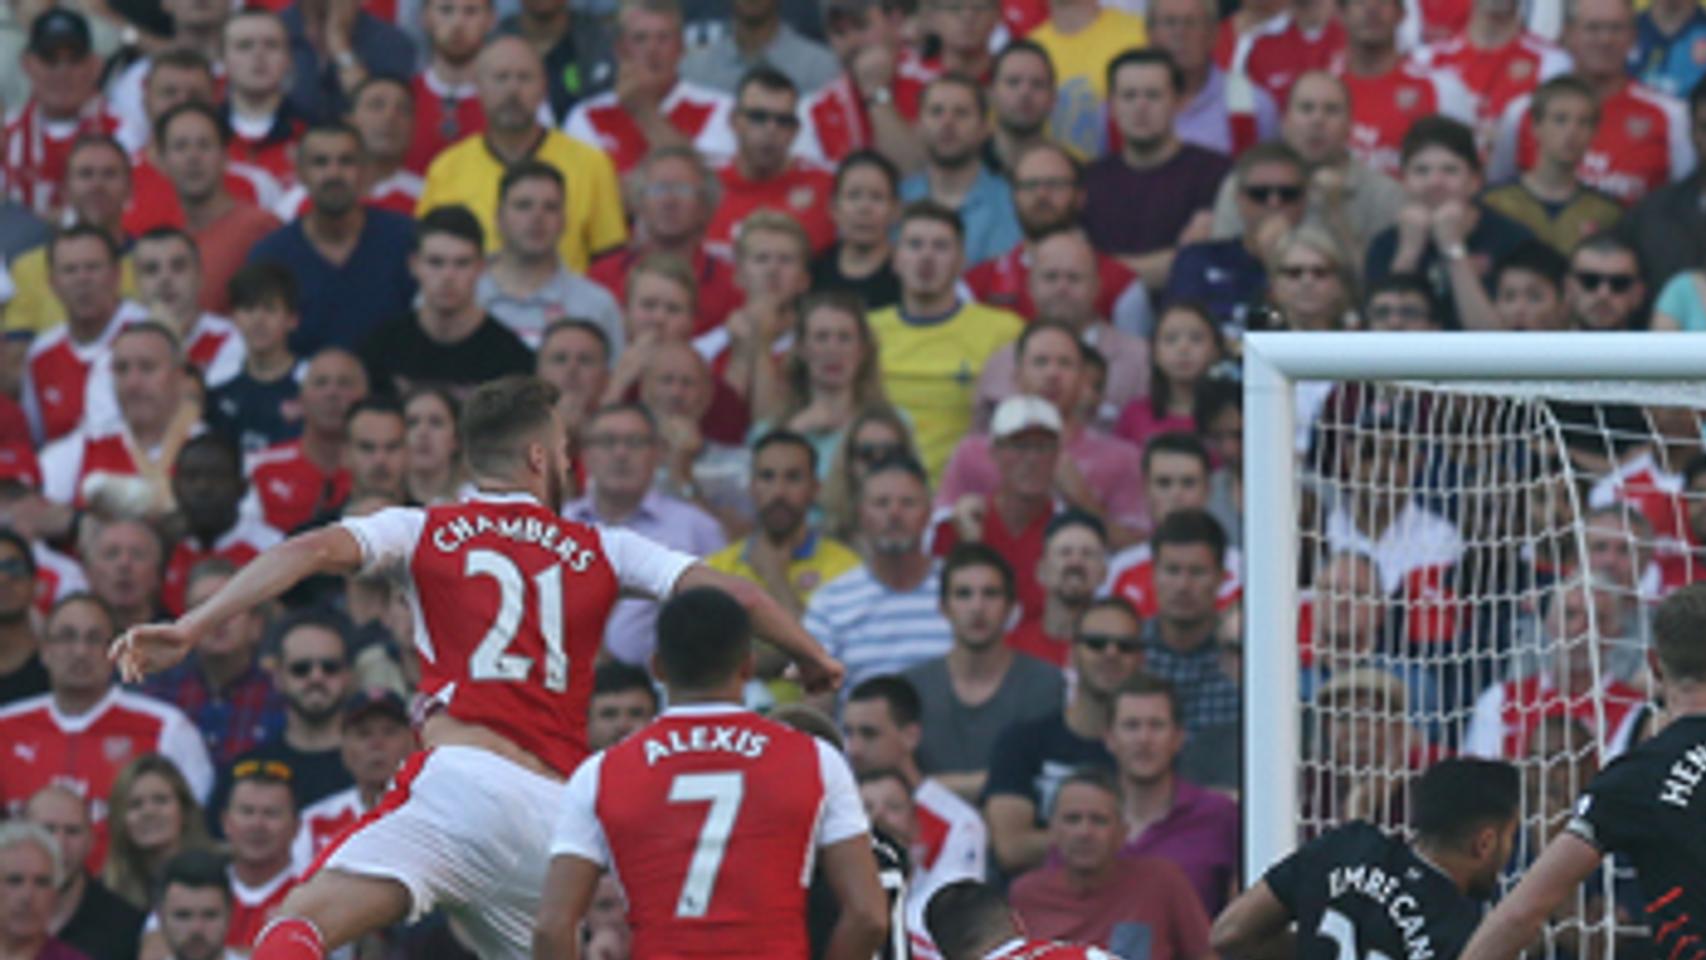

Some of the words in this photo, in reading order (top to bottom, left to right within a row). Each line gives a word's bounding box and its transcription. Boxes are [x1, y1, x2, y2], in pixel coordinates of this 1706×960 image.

[432, 514, 596, 572] CHAMBERS
[464, 547, 569, 694] 21
[644, 725, 769, 767] ALEXIS
[667, 770, 745, 919] 7
